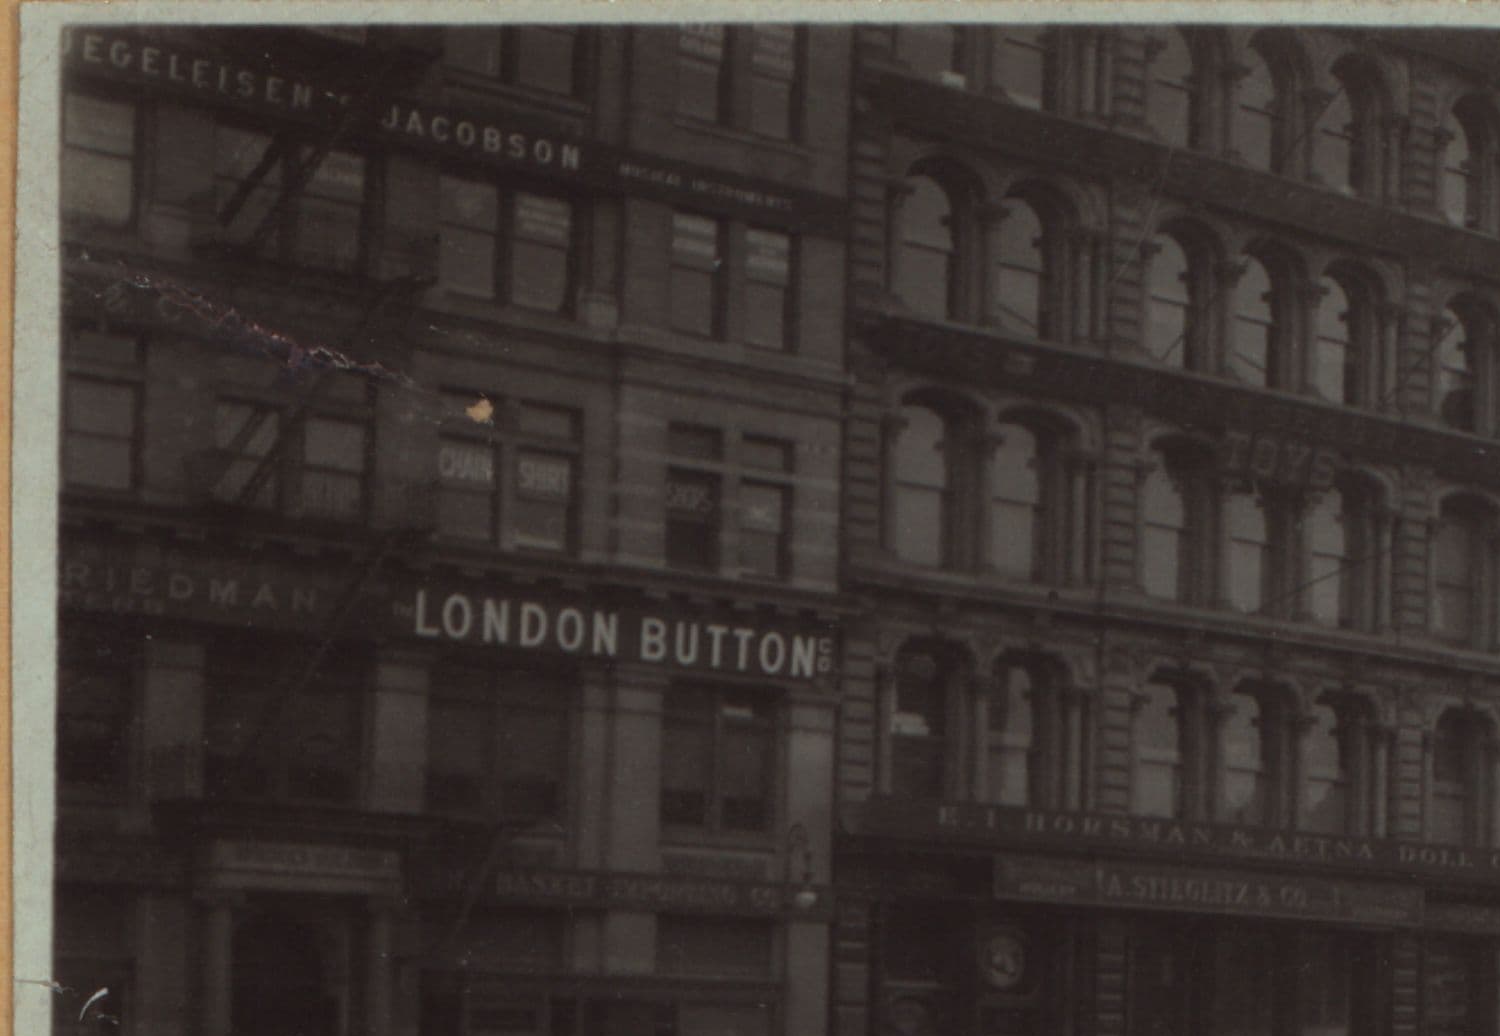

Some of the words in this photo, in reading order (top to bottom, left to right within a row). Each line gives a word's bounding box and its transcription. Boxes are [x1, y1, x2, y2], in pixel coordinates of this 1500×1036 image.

[82, 33, 313, 108] EGELEISEN
[382, 105, 582, 170] JACOBSON
[1226, 433, 1336, 488] TOYS
[414, 588, 620, 658] LONDON
[640, 616, 817, 679] BUTTON
[1025, 811, 1211, 845] HORSMAN
[1399, 845, 1475, 869] DOLL
